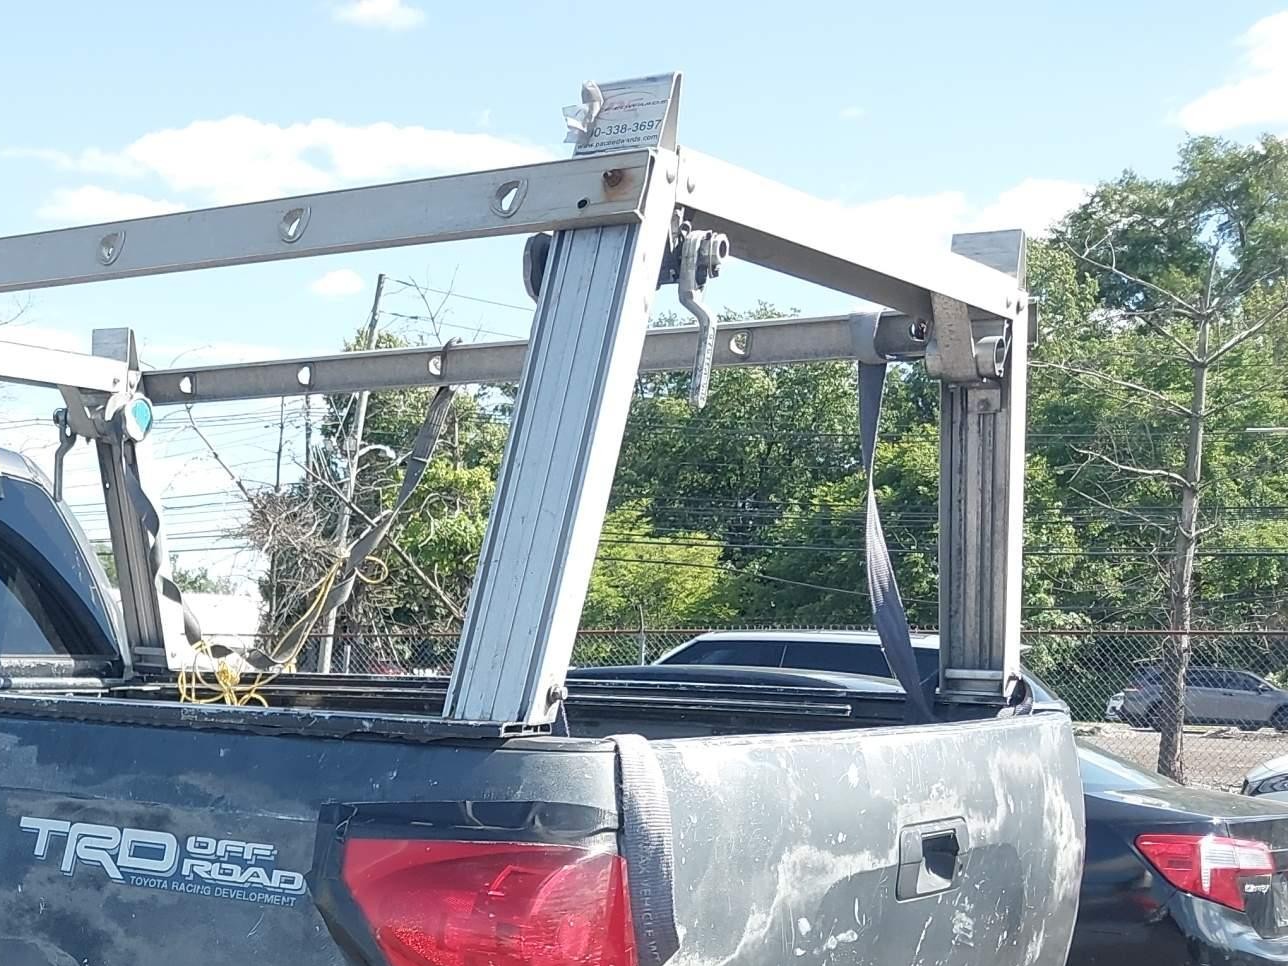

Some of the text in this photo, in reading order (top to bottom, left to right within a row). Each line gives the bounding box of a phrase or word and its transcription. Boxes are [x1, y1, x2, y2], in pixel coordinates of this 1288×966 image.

[19, 816, 180, 883] TRD
[185, 835, 278, 864] OFF
[130, 875, 297, 907] TOYOTA RACING DEVELOPMENT
[181, 858, 309, 895] ROAD
